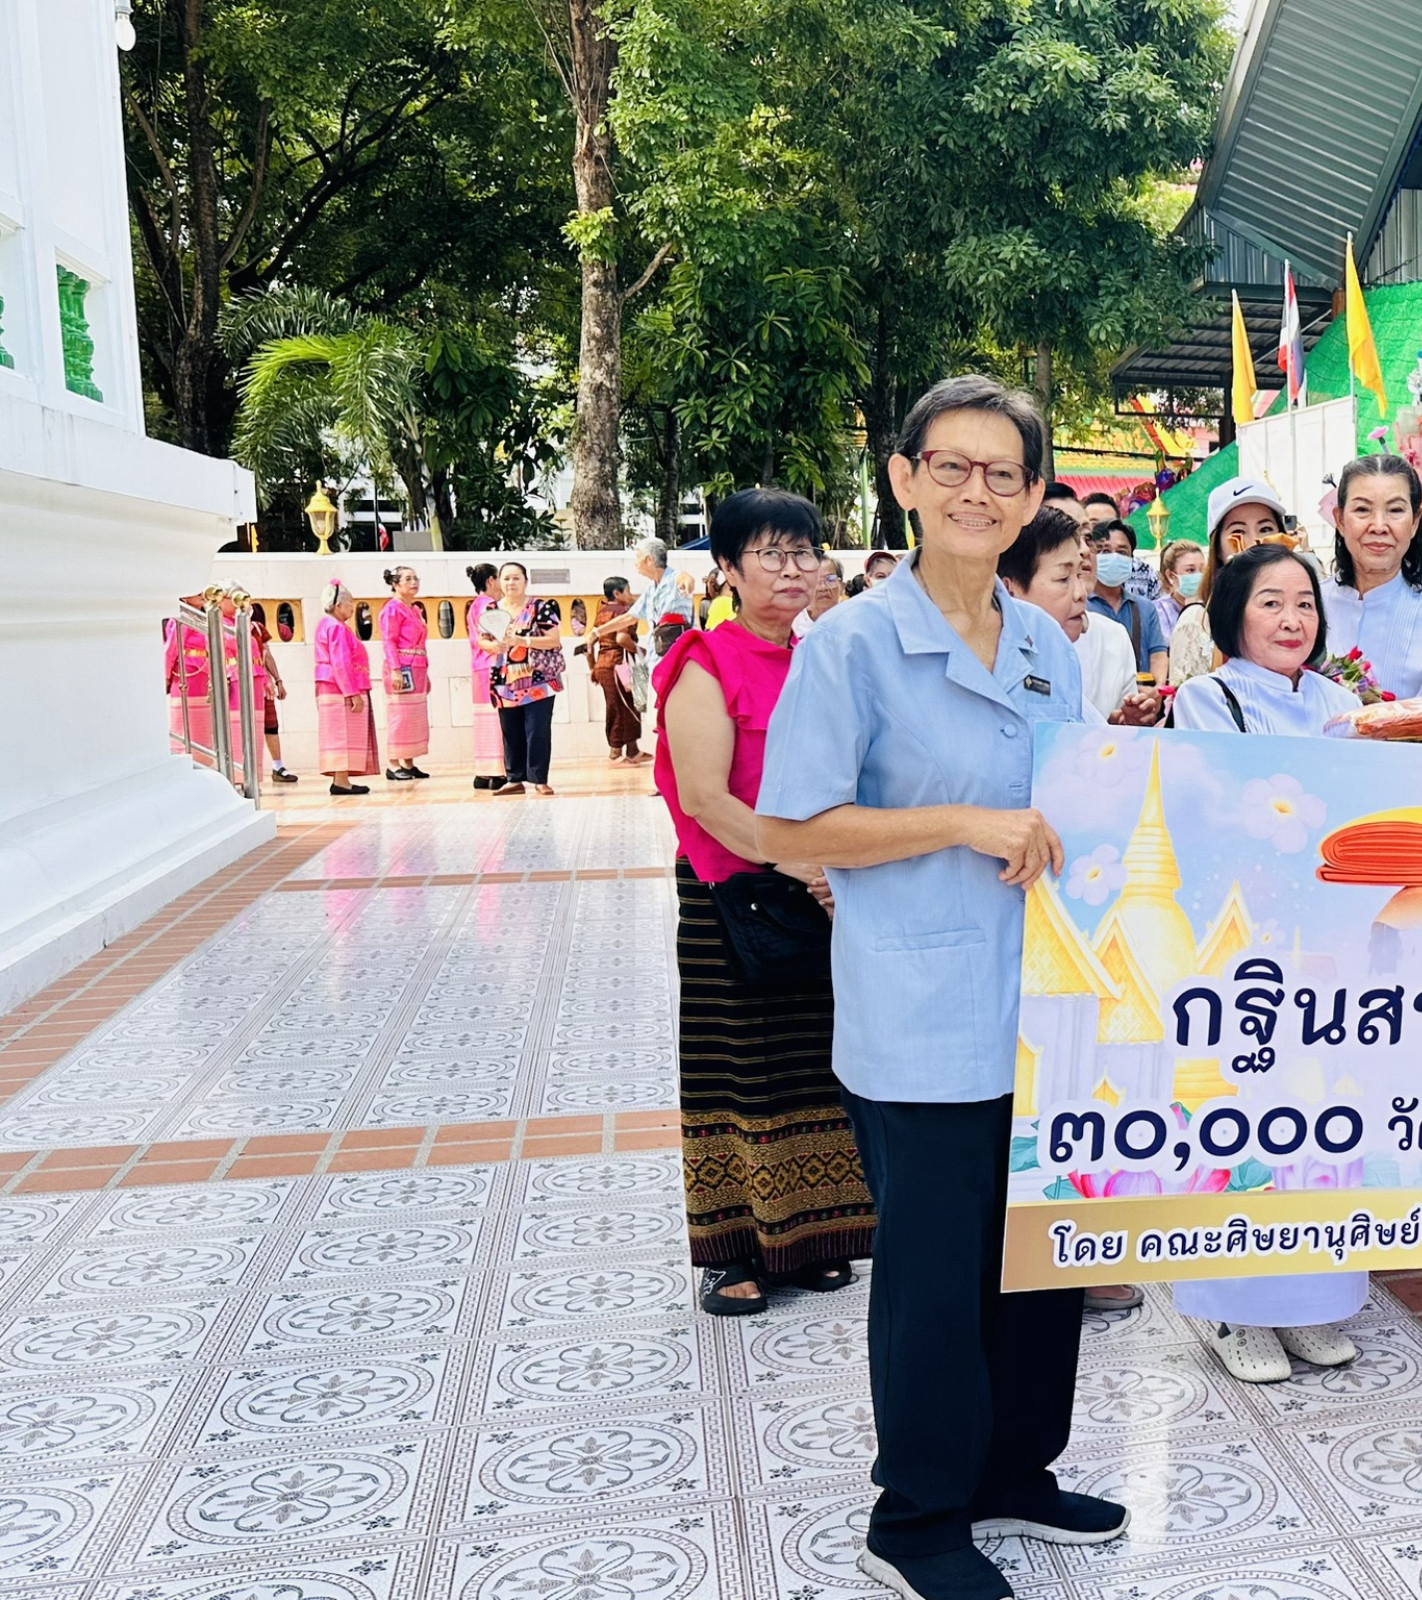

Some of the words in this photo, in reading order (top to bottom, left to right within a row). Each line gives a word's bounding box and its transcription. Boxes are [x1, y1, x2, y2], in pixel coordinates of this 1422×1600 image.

[1049, 1105, 1363, 1172] ๓๐,๐๐๐
[1053, 1225, 1123, 1263] โดย
[1141, 1207, 1421, 1260] คณะศิษยานุศิษย์
